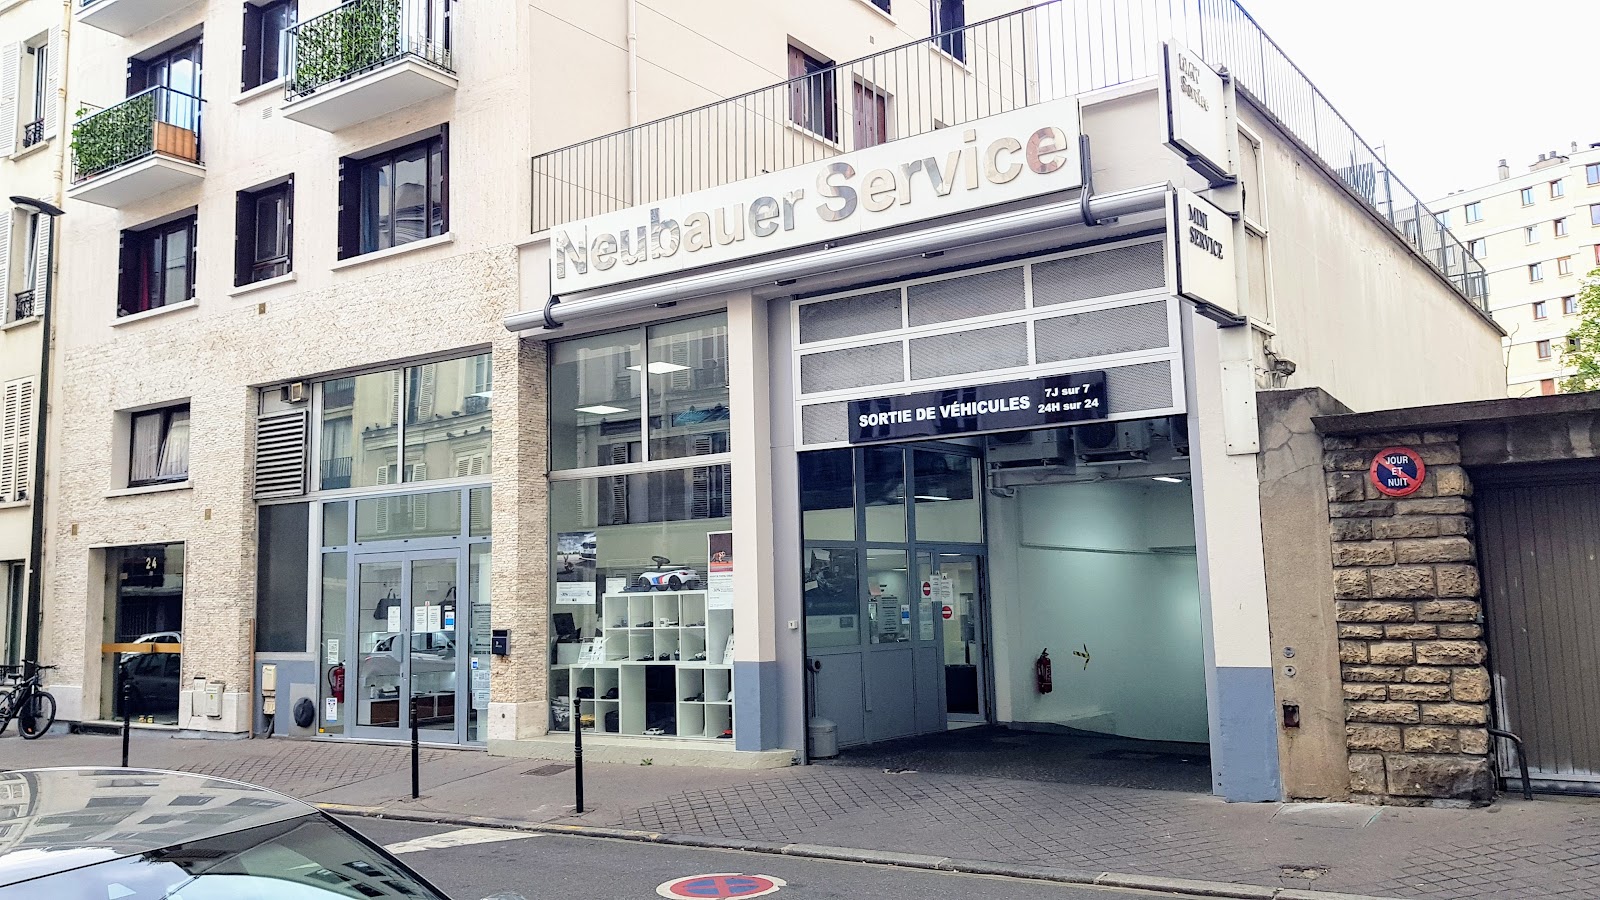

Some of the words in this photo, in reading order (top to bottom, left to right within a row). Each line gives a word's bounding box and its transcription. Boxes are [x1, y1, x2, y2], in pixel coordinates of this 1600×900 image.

[555, 188, 805, 279] Neubauer
[815, 126, 1068, 223] Service
[1188, 203, 1208, 231] MINI
[1189, 225, 1223, 260] SERVICE
[1044, 387, 1059, 398] 7J
[1061, 387, 1080, 396] sur
[1083, 384, 1090, 394] 7
[858, 410, 912, 428] SORTIE
[916, 406, 936, 421] DE
[940, 395, 1031, 419] VÉHICULES
[1038, 402, 1061, 414] 24H
[1062, 401, 1082, 411] sur
[1084, 398, 1099, 409] 24
[1386, 456, 1408, 464] JOUR
[1391, 467, 1402, 475] ET
[1388, 478, 1407, 486] NUIT
[146, 557, 157, 569] 24
